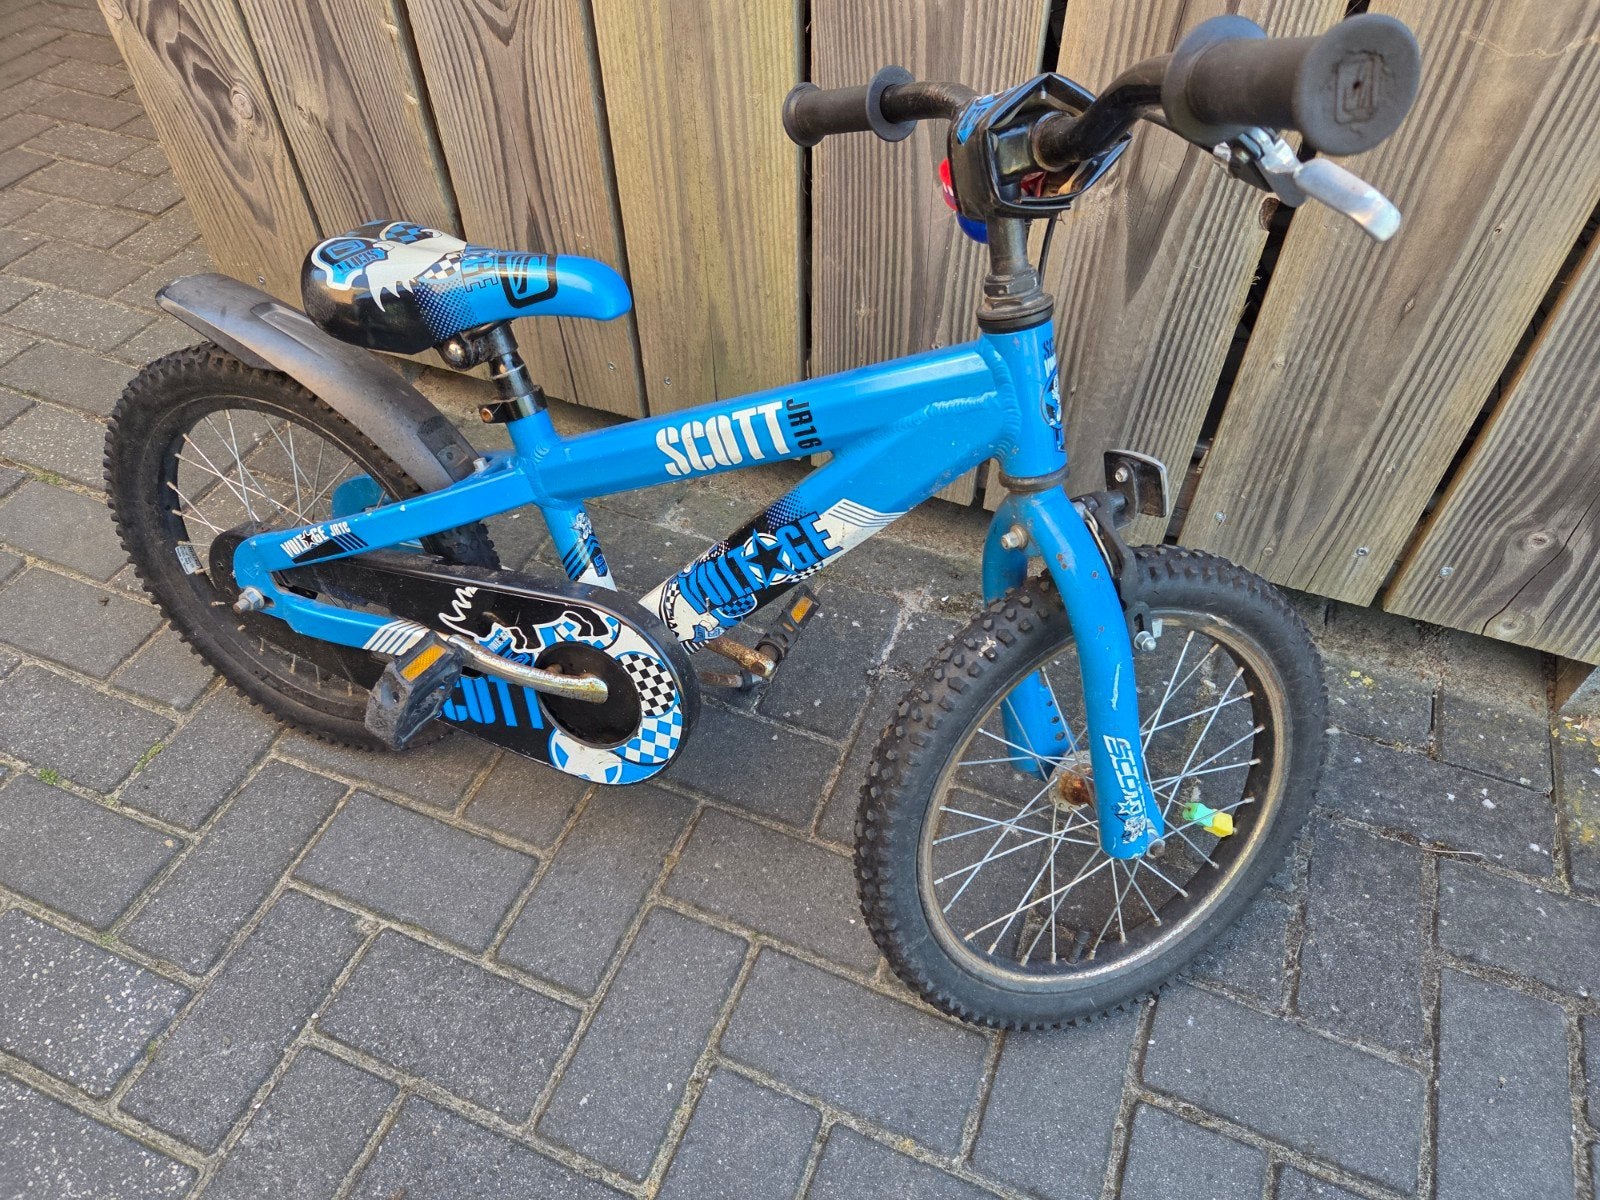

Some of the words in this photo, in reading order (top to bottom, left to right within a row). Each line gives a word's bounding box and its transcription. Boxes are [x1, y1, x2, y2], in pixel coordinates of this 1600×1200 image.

[655, 400, 790, 476] SCOTT
[786, 398, 822, 449] JR16
[280, 525, 329, 558] VOLTGE
[677, 511, 844, 614] VOLTGE
[440, 674, 544, 730] COTT
